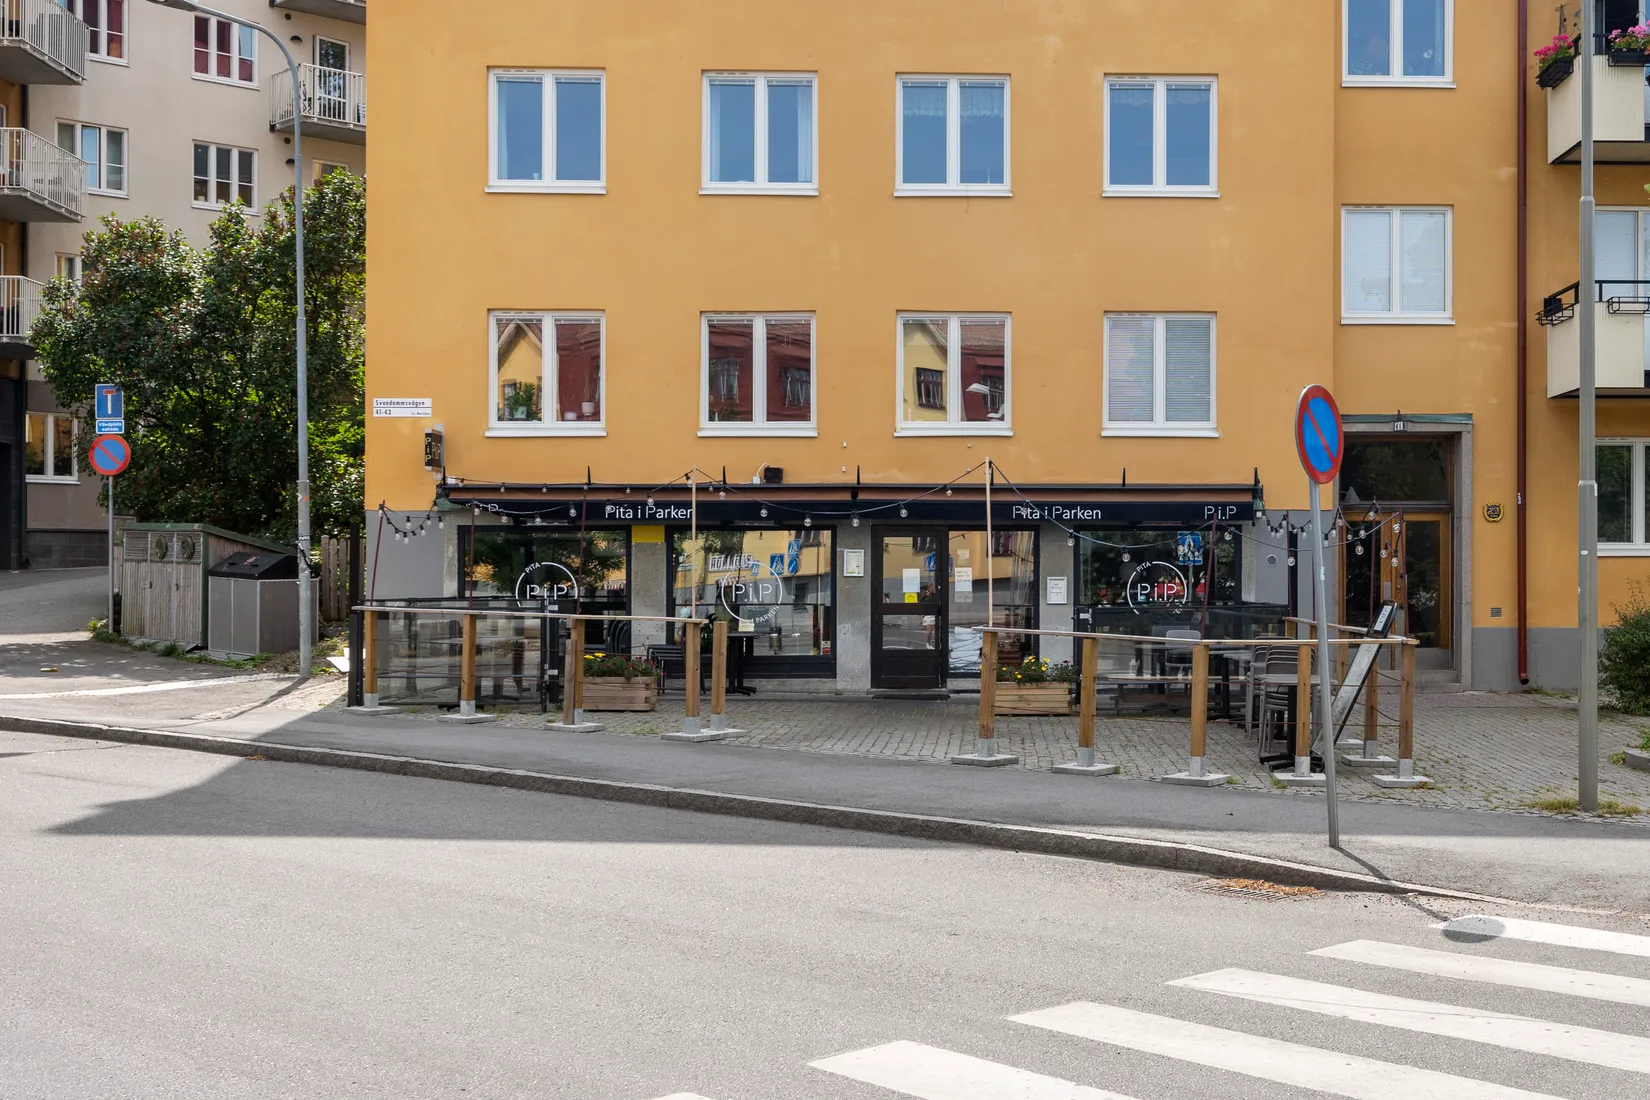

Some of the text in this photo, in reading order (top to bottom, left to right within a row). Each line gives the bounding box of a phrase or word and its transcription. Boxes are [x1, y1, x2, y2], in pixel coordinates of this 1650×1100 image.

[375, 399, 425, 408] Svandammsvägen
[375, 408, 392, 416] 41-43
[605, 505, 633, 519] Pita
[637, 505, 641, 519] i
[1012, 505, 1101, 519] Pita i Parken
[524, 562, 541, 574] PITA
[1136, 561, 1152, 572] PITA
